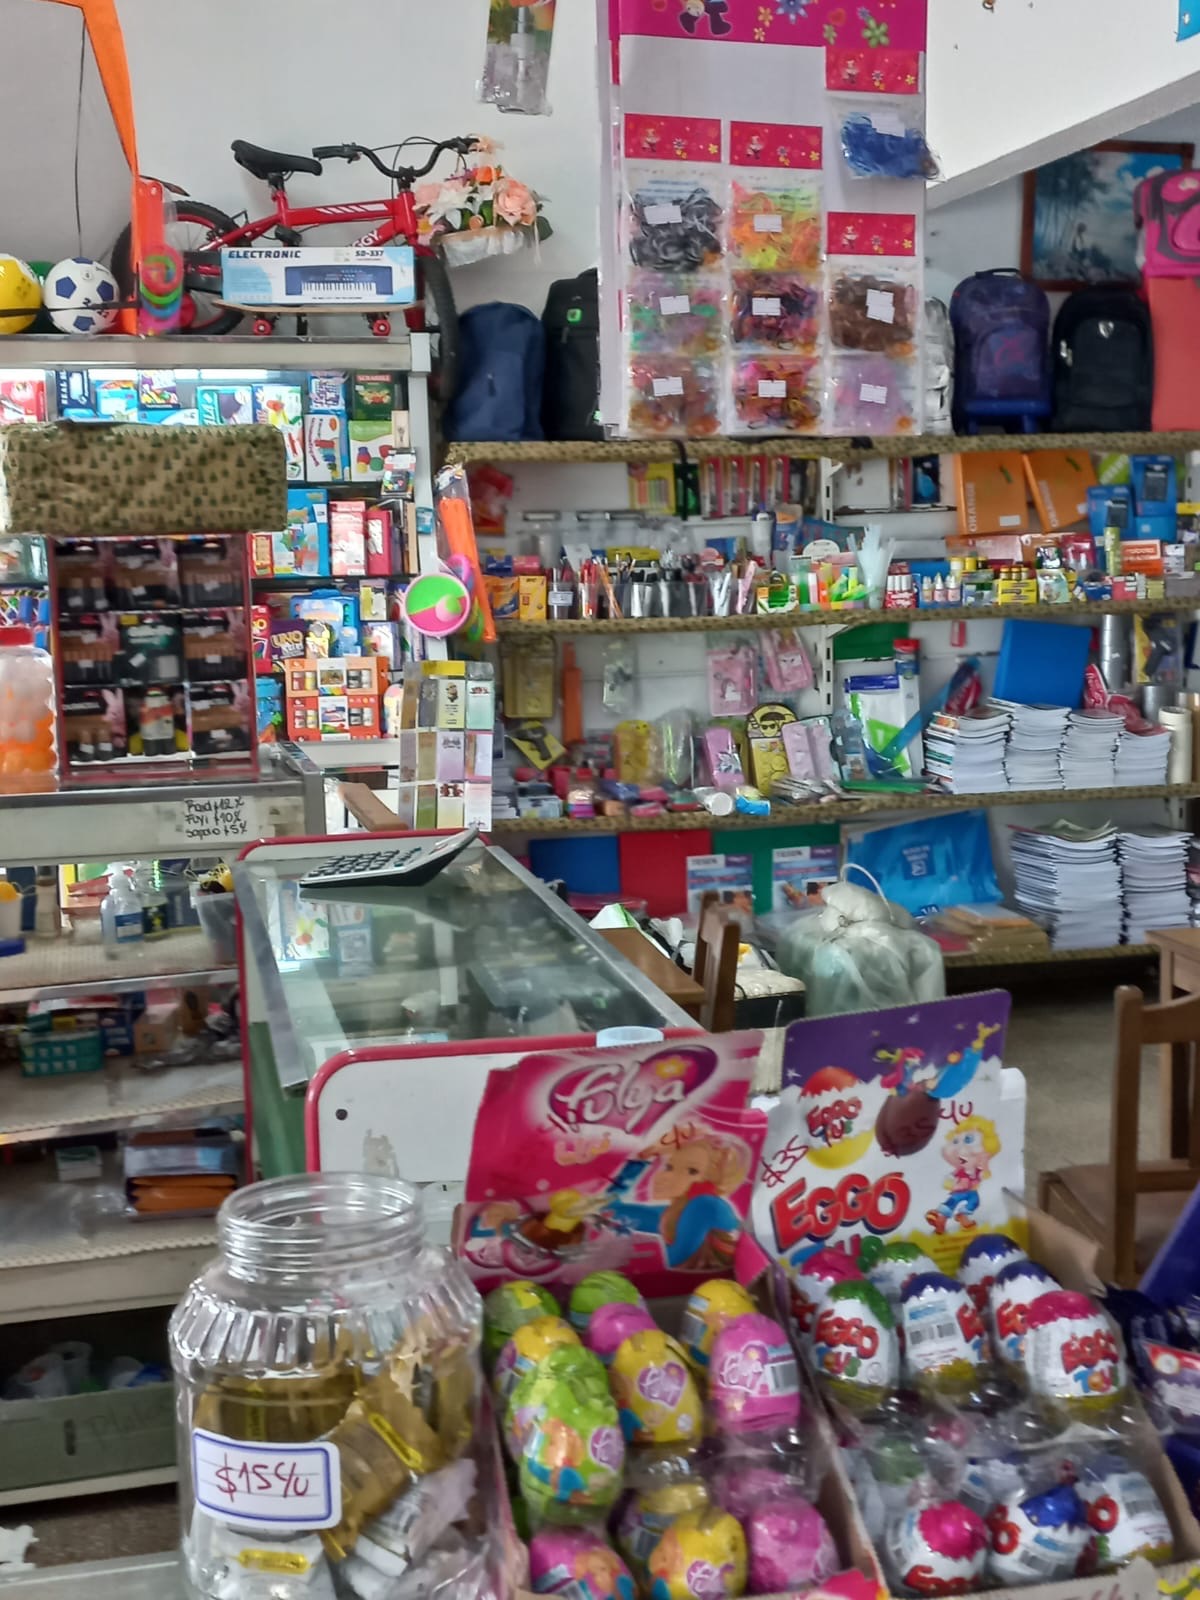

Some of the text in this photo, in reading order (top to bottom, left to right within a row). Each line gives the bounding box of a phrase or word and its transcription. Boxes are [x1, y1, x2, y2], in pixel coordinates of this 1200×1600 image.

[228, 250, 302, 259] ELECTRONIC
[271, 630, 303, 648] UNO
[769, 1171, 911, 1254] EGGO
[814, 1308, 880, 1360] EGGO
